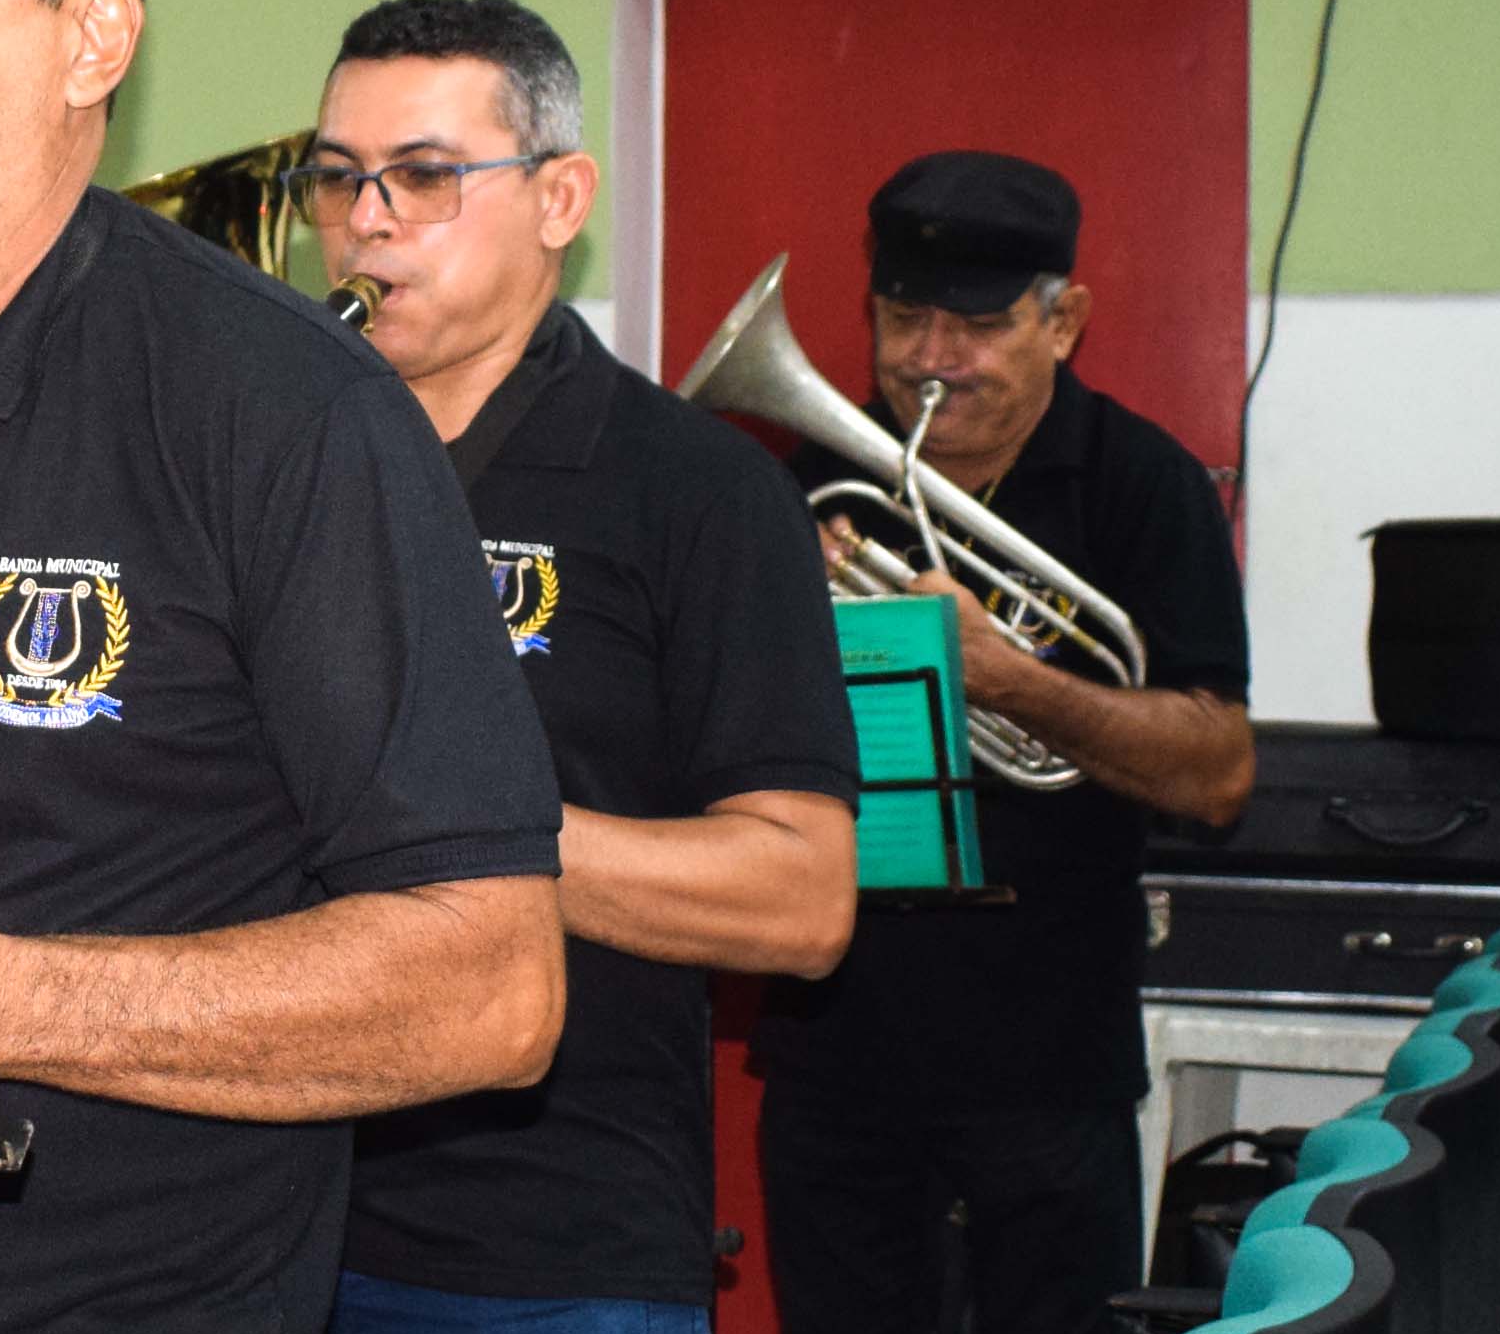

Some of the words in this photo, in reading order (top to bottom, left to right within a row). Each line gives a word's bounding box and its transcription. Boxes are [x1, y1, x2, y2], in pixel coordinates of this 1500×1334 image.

[0, 556, 43, 573] BANDA
[45, 557, 120, 578] MUNICIPAL
[7, 674, 45, 689] DESDE
